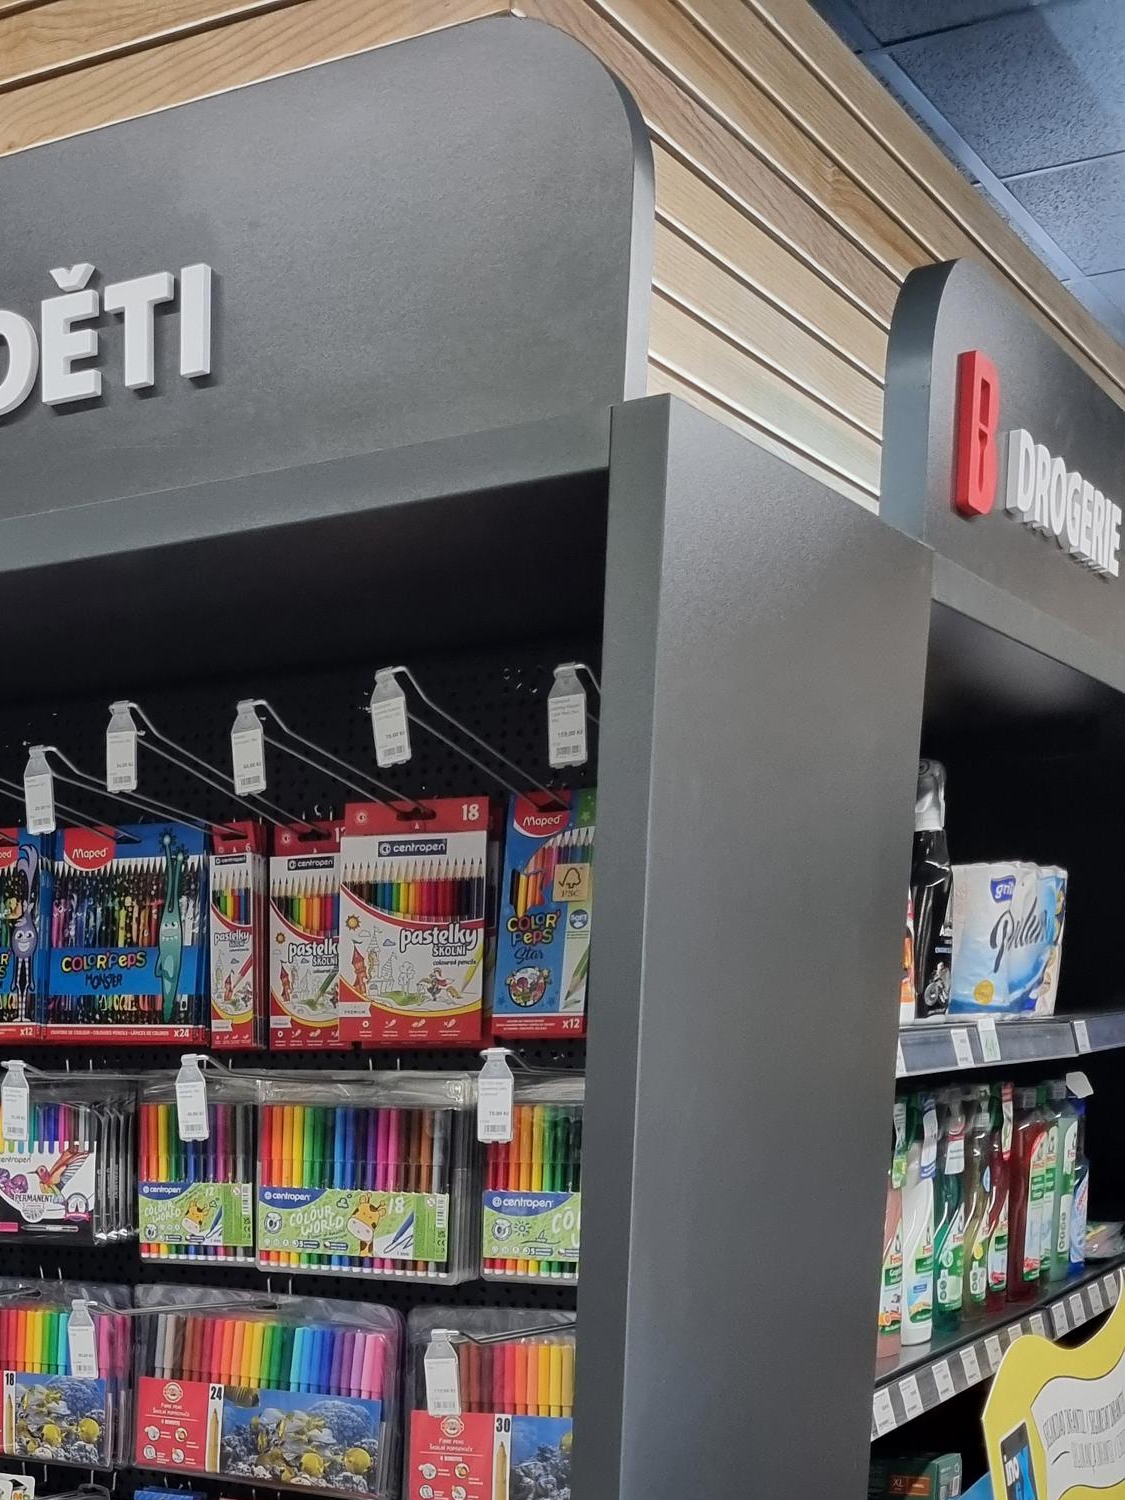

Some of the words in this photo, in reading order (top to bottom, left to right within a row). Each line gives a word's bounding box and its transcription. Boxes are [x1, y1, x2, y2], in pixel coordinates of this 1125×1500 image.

[1006, 429, 1123, 578] DROGERIE
[462, 805, 479, 821] 18
[523, 814, 562, 827] Maped
[72, 847, 108, 859] Maped
[245, 842, 252, 852] 6
[393, 841, 446, 855] centropen
[297, 859, 334, 869] centropen
[214, 929, 251, 946] pastelky
[399, 921, 480, 954] pastelky
[432, 944, 468, 957] ŠKOLNÍ
[84, 972, 123, 991] MONSTER
[562, 1018, 581, 1030] x12
[20, 1027, 34, 1037] x12
[174, 1028, 191, 1039] x24
[150, 1186, 182, 1195] centropen
[272, 1192, 311, 1202] centropen
[14, 1193, 54, 1203] PERMANENT
[503, 1196, 553, 1209] centropen
[388, 1196, 405, 1215] 18
[289, 1204, 335, 1227] COLOUR
[301, 1216, 345, 1236] WORLD
[5, 1372, 15, 1386] 18
[210, 1386, 222, 1401] 24
[496, 1417, 511, 1433] 30
